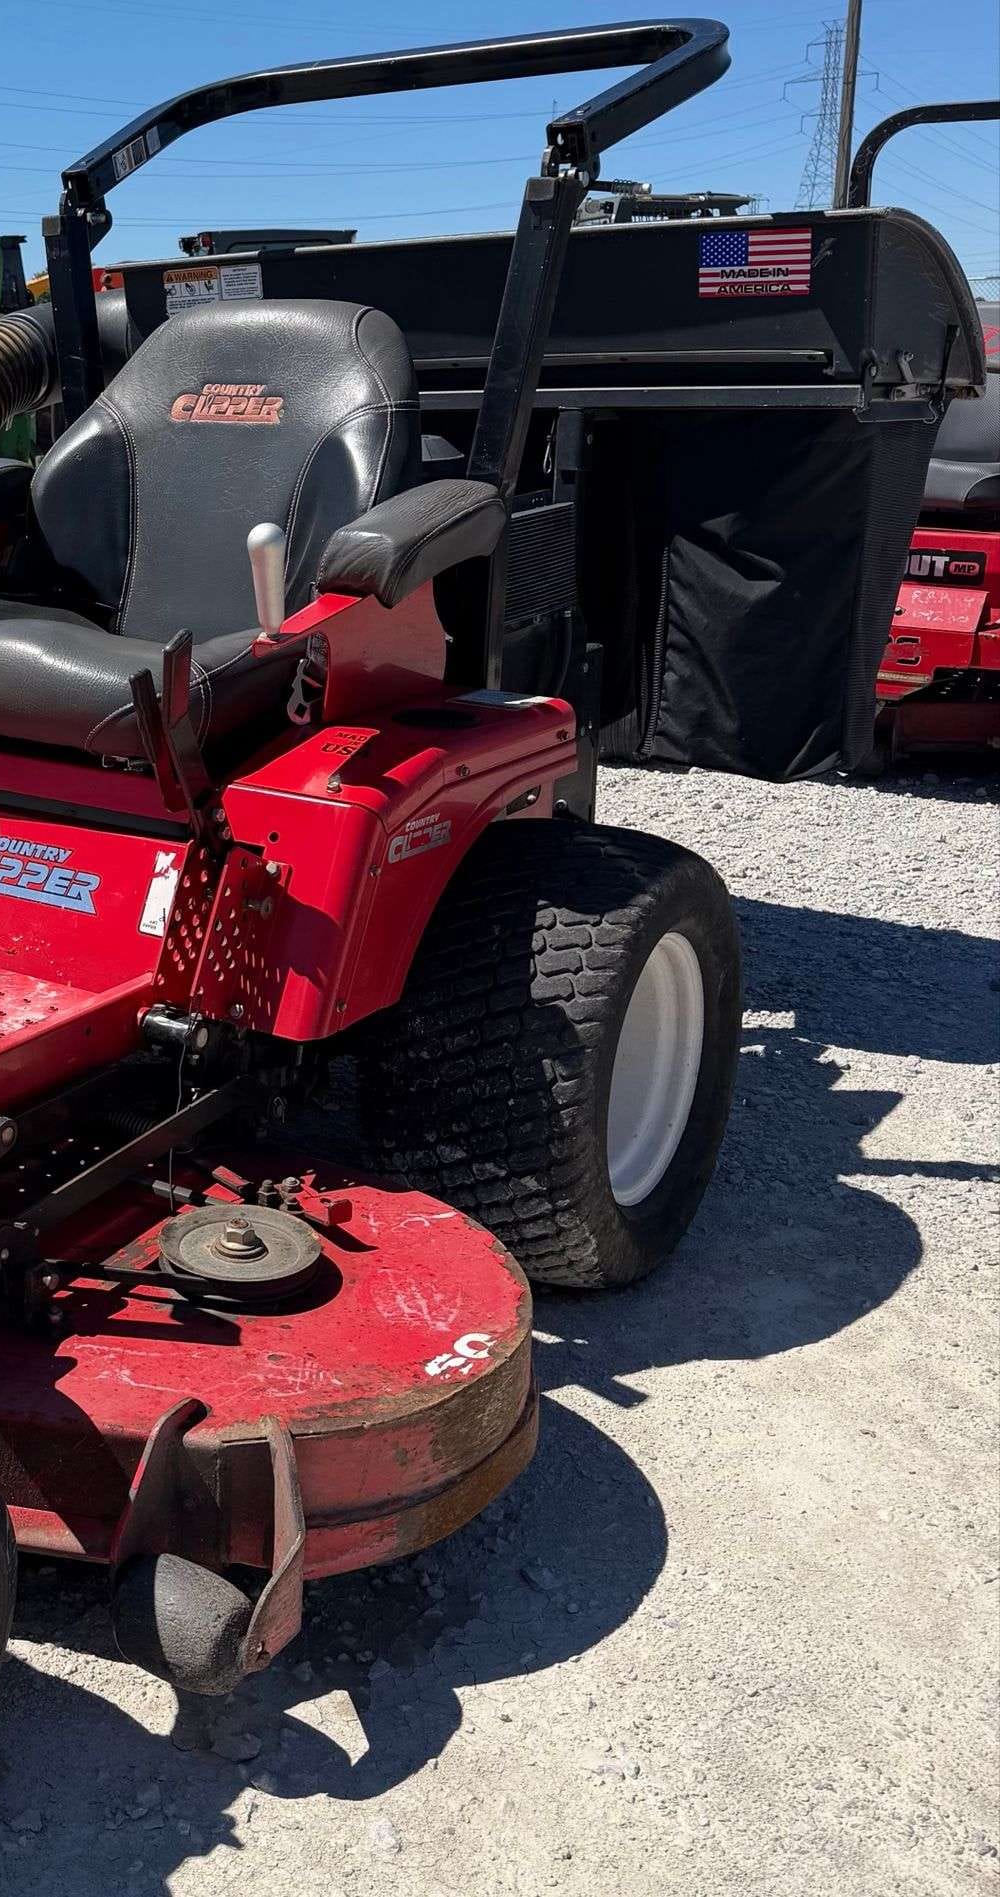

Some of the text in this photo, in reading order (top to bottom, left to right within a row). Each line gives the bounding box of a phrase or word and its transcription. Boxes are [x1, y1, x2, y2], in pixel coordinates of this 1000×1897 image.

[174, 271, 214, 282] WARNING
[720, 267, 790, 279] MADE IN
[717, 284, 792, 295] AMERICA
[202, 384, 267, 396] COUNTRY
[170, 394, 285, 425] CLIPPER
[953, 564, 976, 574] MP
